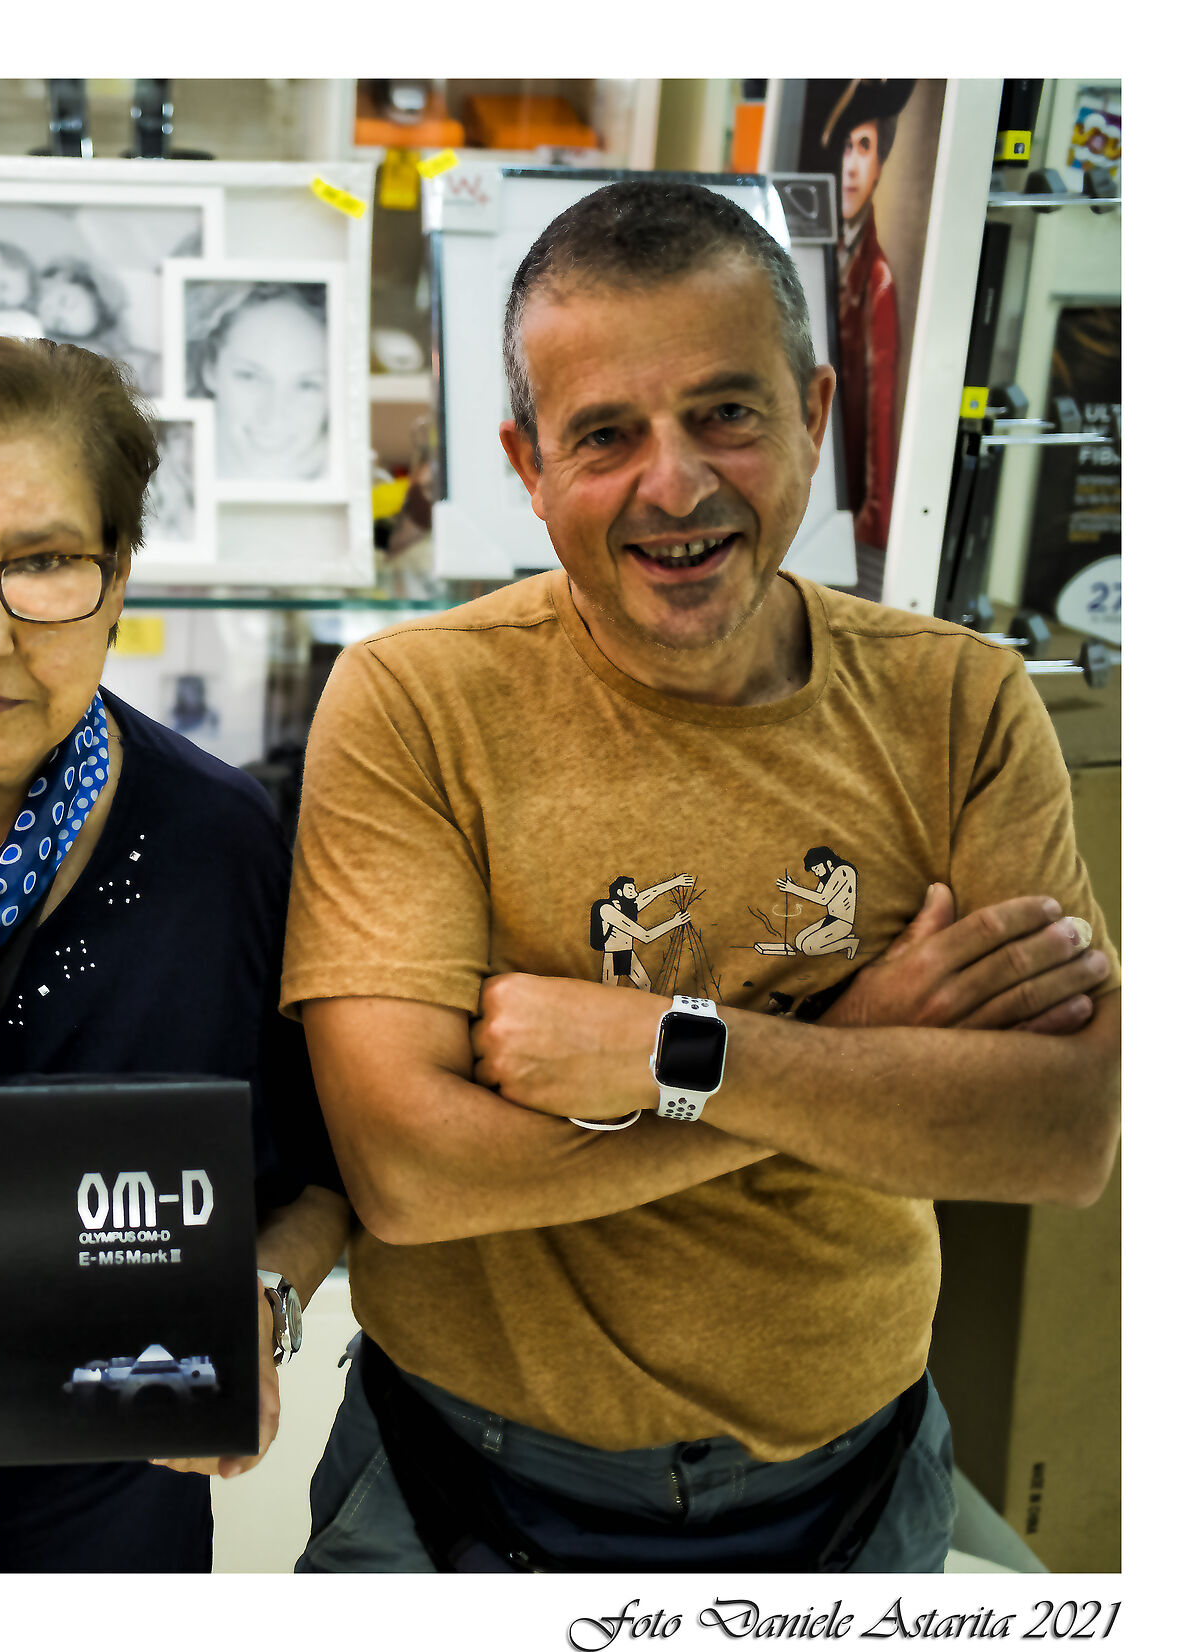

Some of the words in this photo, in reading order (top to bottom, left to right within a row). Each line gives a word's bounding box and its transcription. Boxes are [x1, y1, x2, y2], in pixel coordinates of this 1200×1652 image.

[77, 1169, 214, 1230] OM-D
[78, 1230, 136, 1245] OLYMPUS
[137, 1229, 171, 1243] OM-D
[126, 1249, 168, 1264] Mark
